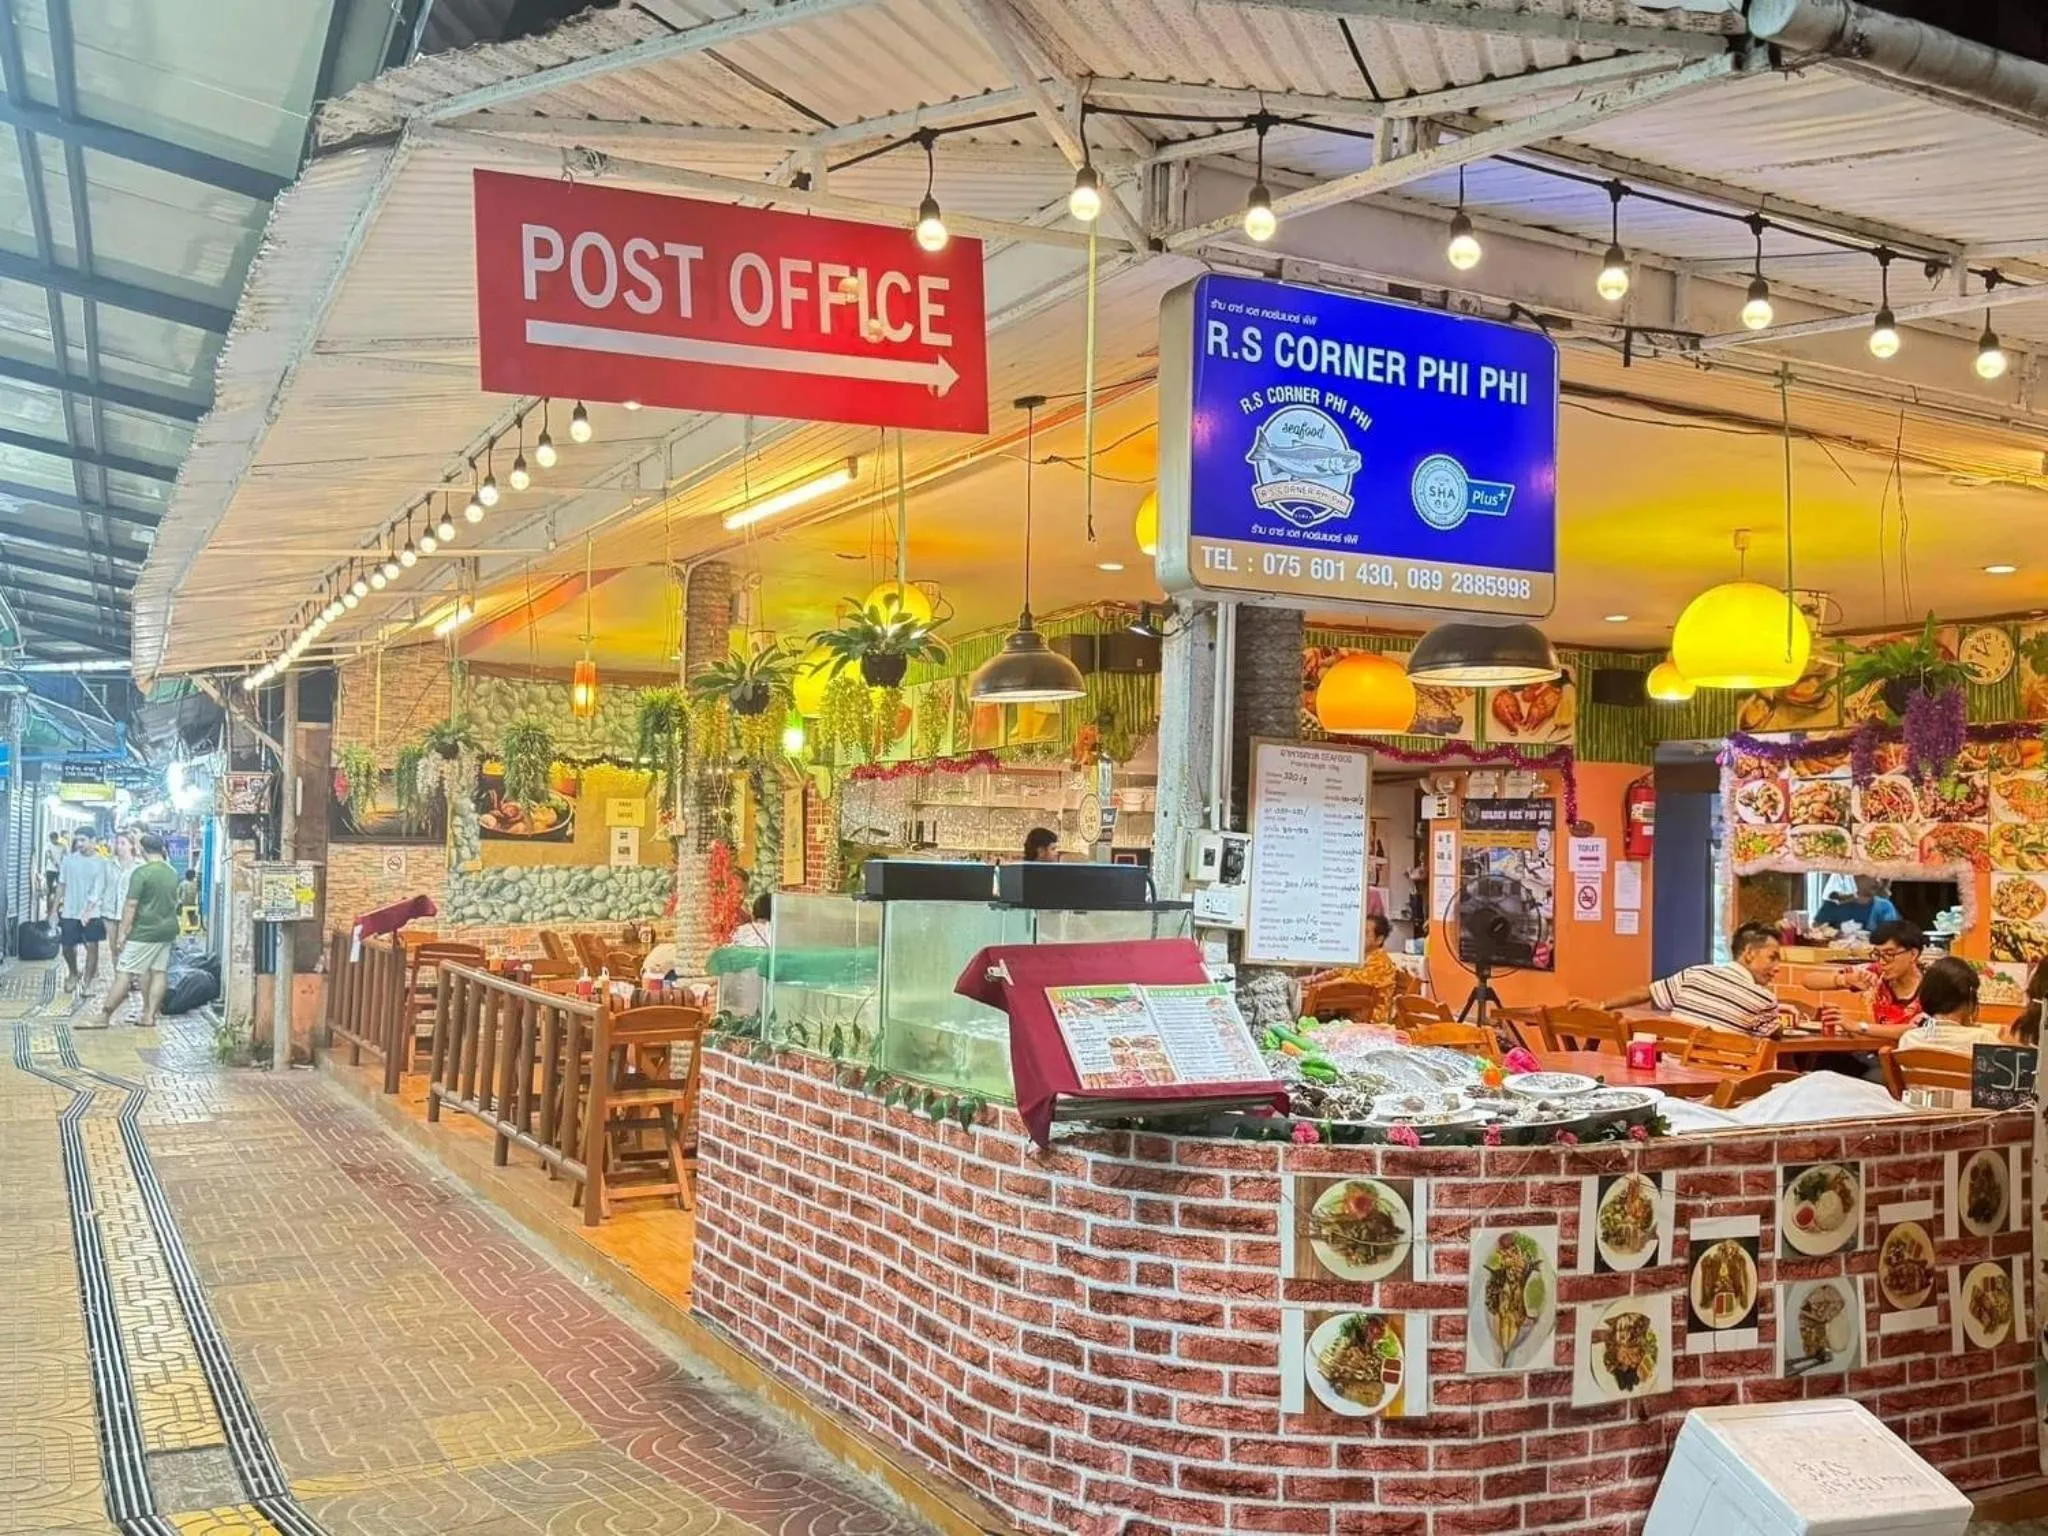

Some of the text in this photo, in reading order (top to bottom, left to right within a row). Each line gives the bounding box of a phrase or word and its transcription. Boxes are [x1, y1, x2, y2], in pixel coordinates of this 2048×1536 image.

[522, 223, 953, 347] POST OFFICE
[1207, 319, 1529, 406] R.S CORNER PHI PHI
[1240, 386, 1374, 432] R.S CORNER PHI PHI
[1281, 421, 1326, 440] seafood
[1429, 485, 1456, 500] SHA
[1201, 545, 1238, 572] TEL
[1263, 551, 1300, 578] 075
[1310, 555, 1345, 582] 601
[1355, 559, 1399, 590] 430,
[1407, 563, 1442, 591] 089
[1451, 567, 1531, 599] 2885998
